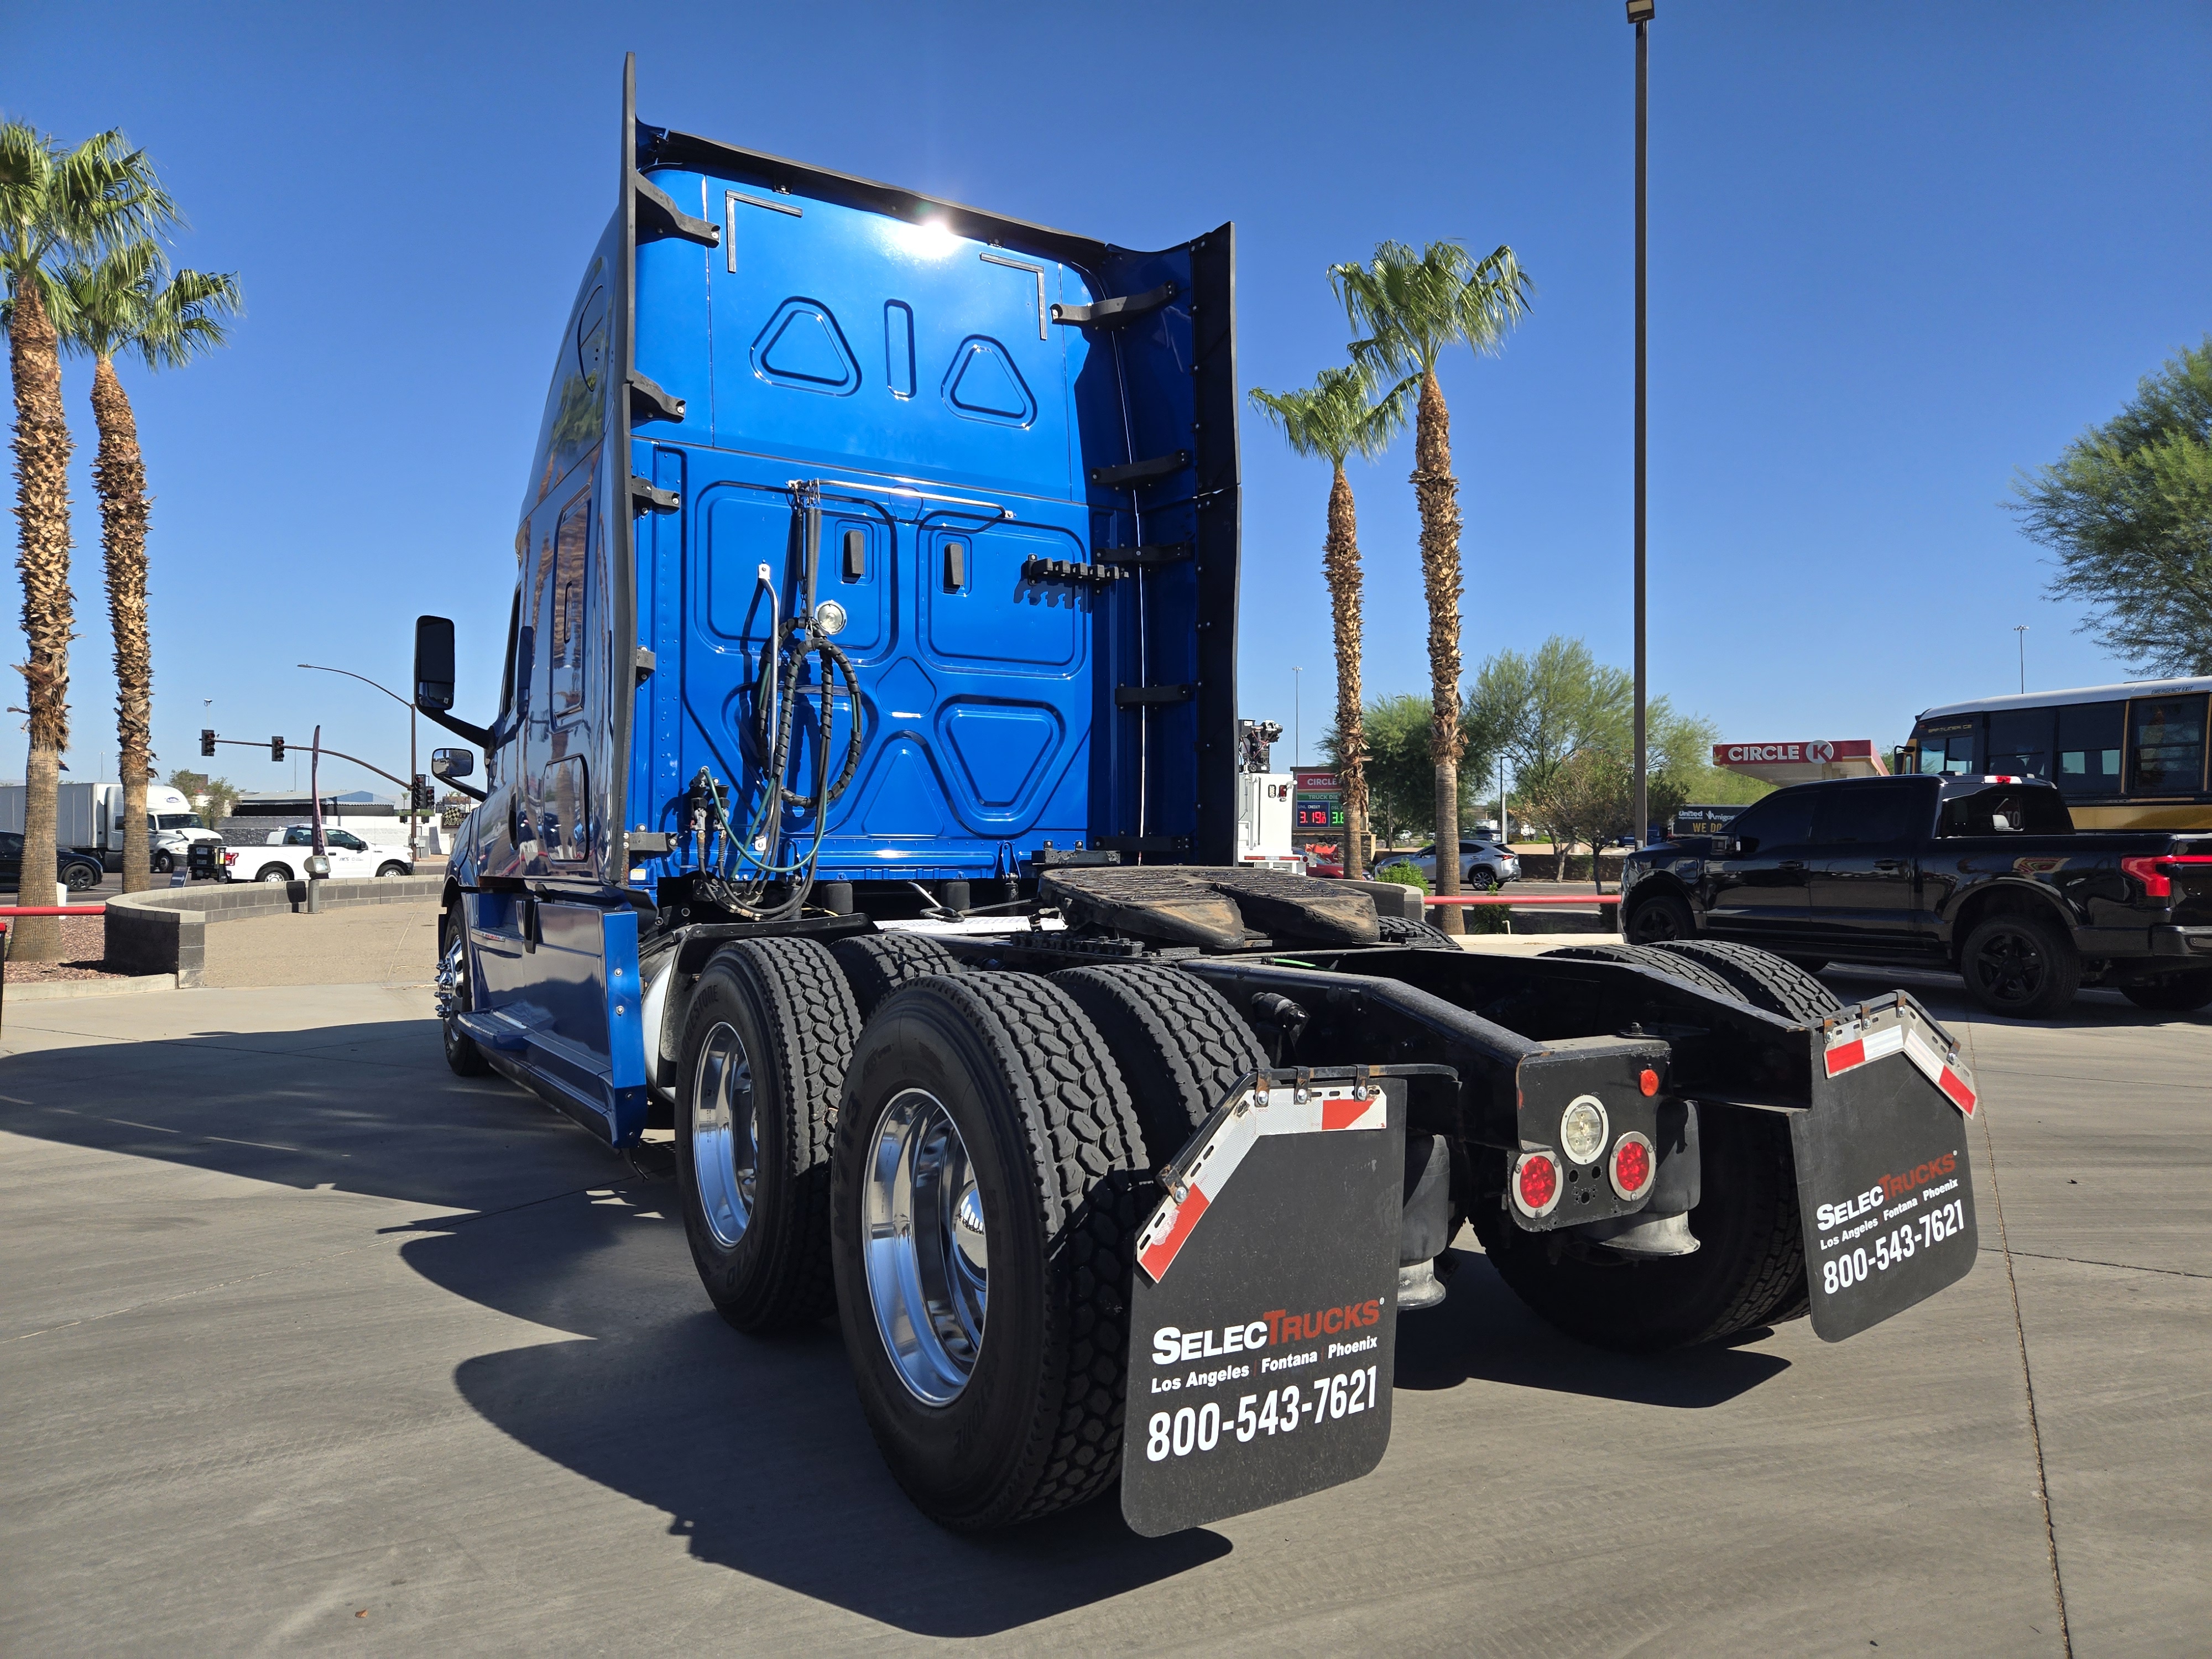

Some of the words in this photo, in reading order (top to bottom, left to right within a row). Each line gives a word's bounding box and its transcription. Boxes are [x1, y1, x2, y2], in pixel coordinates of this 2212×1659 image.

[1728, 745, 1799, 761] CIRCLE
[1811, 743, 1832, 763] K
[1693, 822, 1707, 832] WE
[1820, 1237, 1839, 1250] Los
[1842, 1217, 1879, 1241] Angeles
[1883, 1197, 1918, 1221] Fontana
[1922, 1178, 1958, 1202] Phoenix
[1823, 1199, 1964, 1295] 800-543-7621
[1151, 1378, 1181, 1394] Los
[1186, 1363, 1250, 1387] Angeles
[1261, 1351, 1318, 1374] Fontana
[1328, 1335, 1378, 1359] Phoenix
[1146, 1365, 1377, 1462] 800-543-7621
